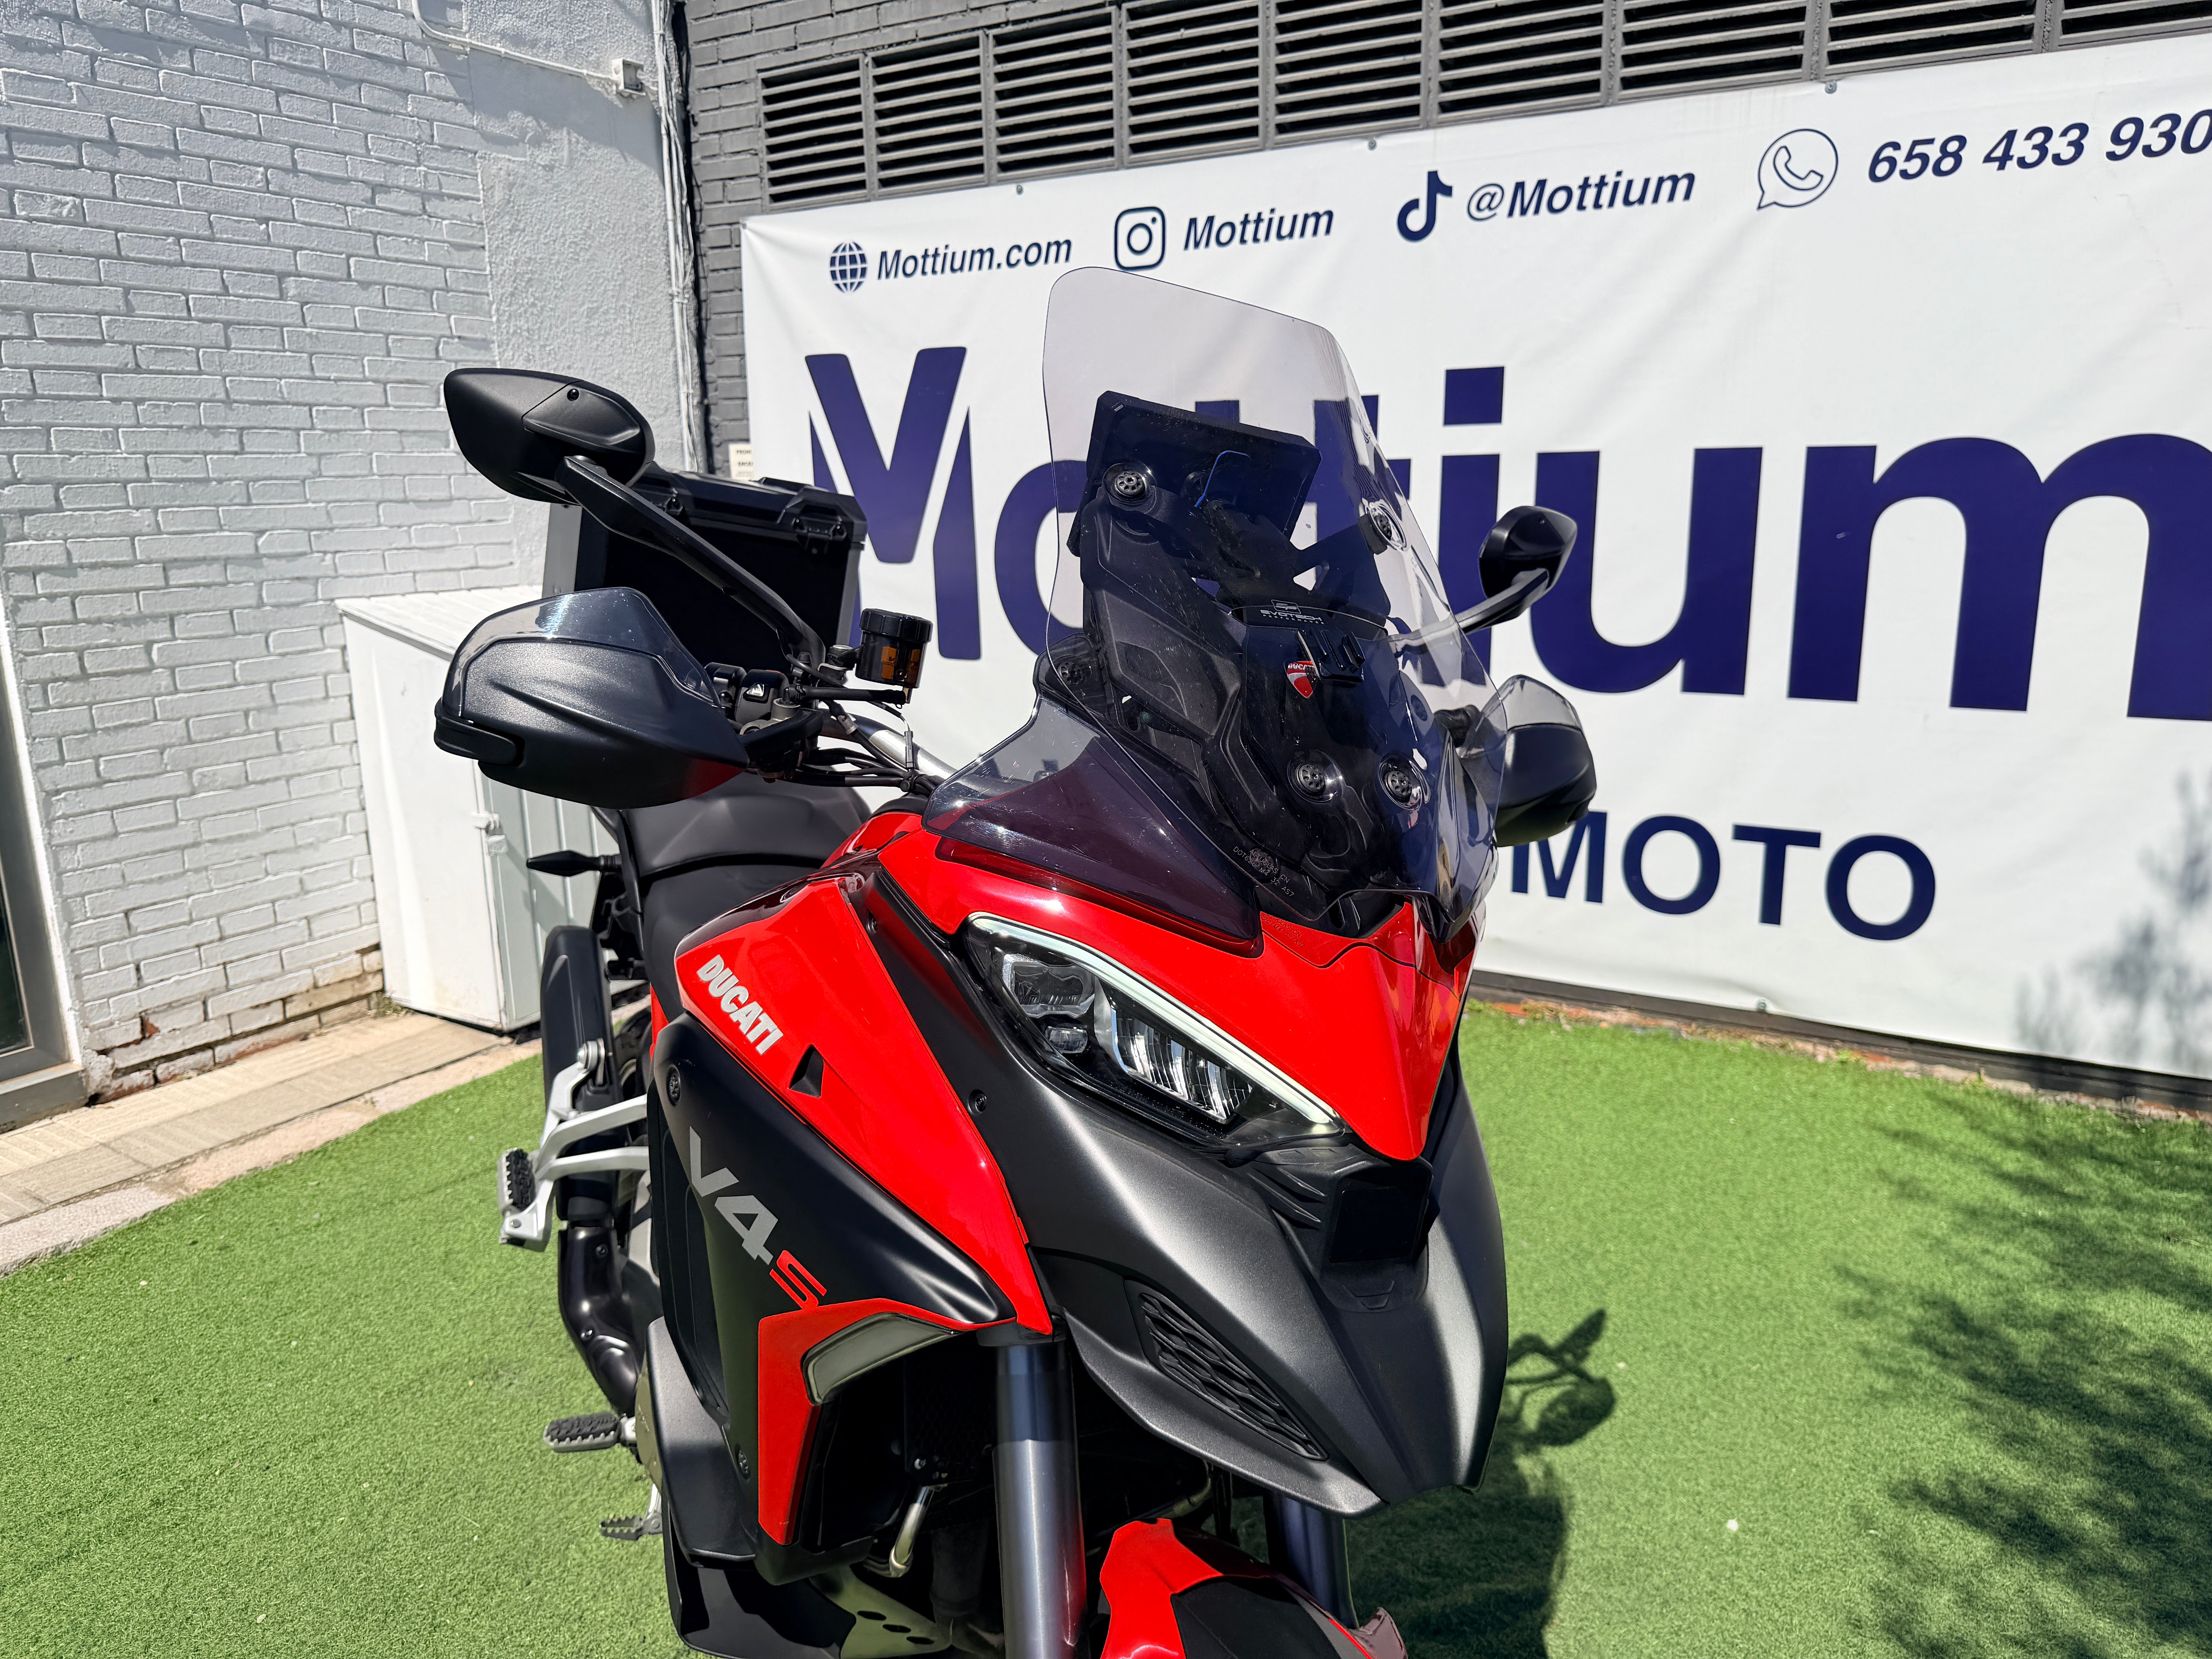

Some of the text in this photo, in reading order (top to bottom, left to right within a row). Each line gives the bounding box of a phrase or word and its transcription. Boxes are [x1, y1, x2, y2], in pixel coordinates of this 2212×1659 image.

[1868, 108, 2212, 183] 658 433 930
[1467, 170, 1695, 222] @Mottium
[1183, 210, 1334, 251] Mottium
[877, 239, 1072, 280] Mottium.com
[802, 346, 2212, 722] Motium
[1260, 609, 1322, 621] EVOTECH
[1280, 874, 1290, 883] CN
[1281, 886, 1295, 897] AS7
[1511, 810, 1937, 941] MOTO
[696, 954, 784, 1055] DUCATI
